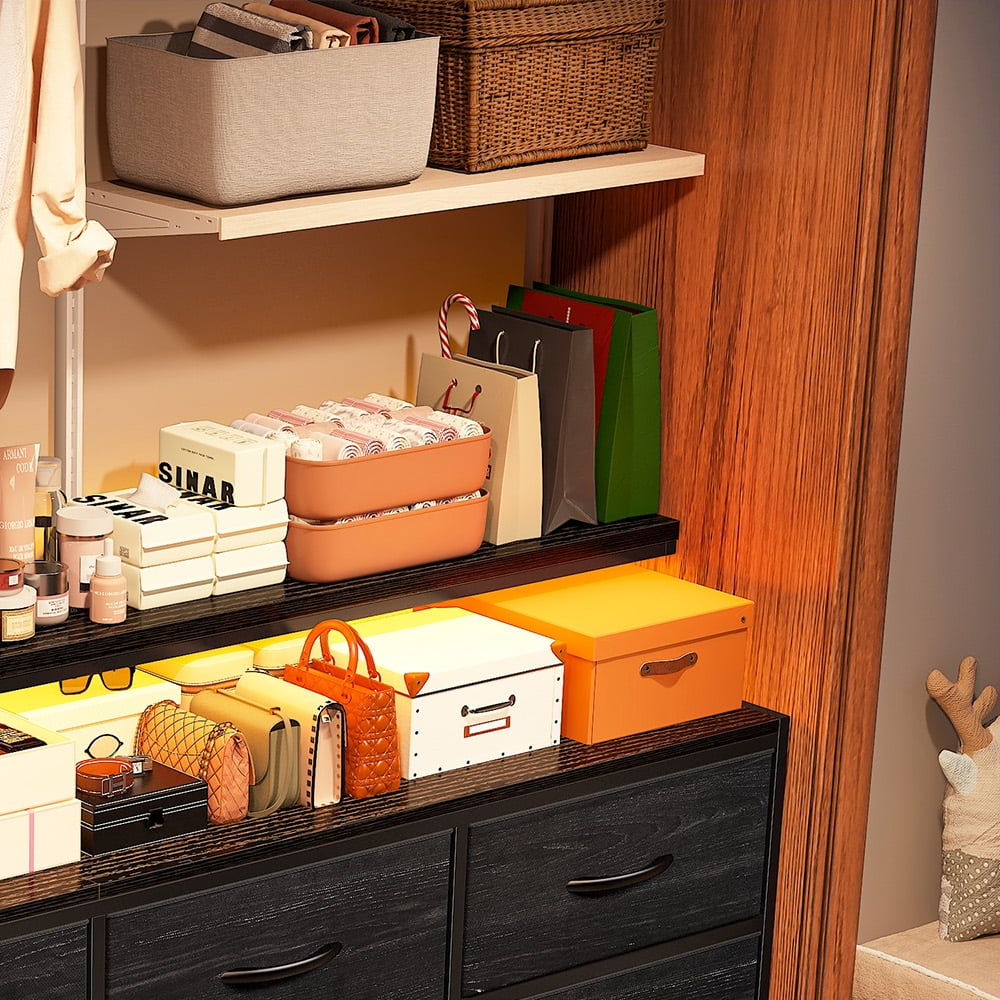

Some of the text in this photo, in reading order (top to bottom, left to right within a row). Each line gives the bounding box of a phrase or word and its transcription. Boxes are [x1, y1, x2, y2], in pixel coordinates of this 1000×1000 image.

[3, 448, 27, 460] ARMANI
[158, 462, 235, 504] SINAR
[73, 495, 169, 525] SINAR
